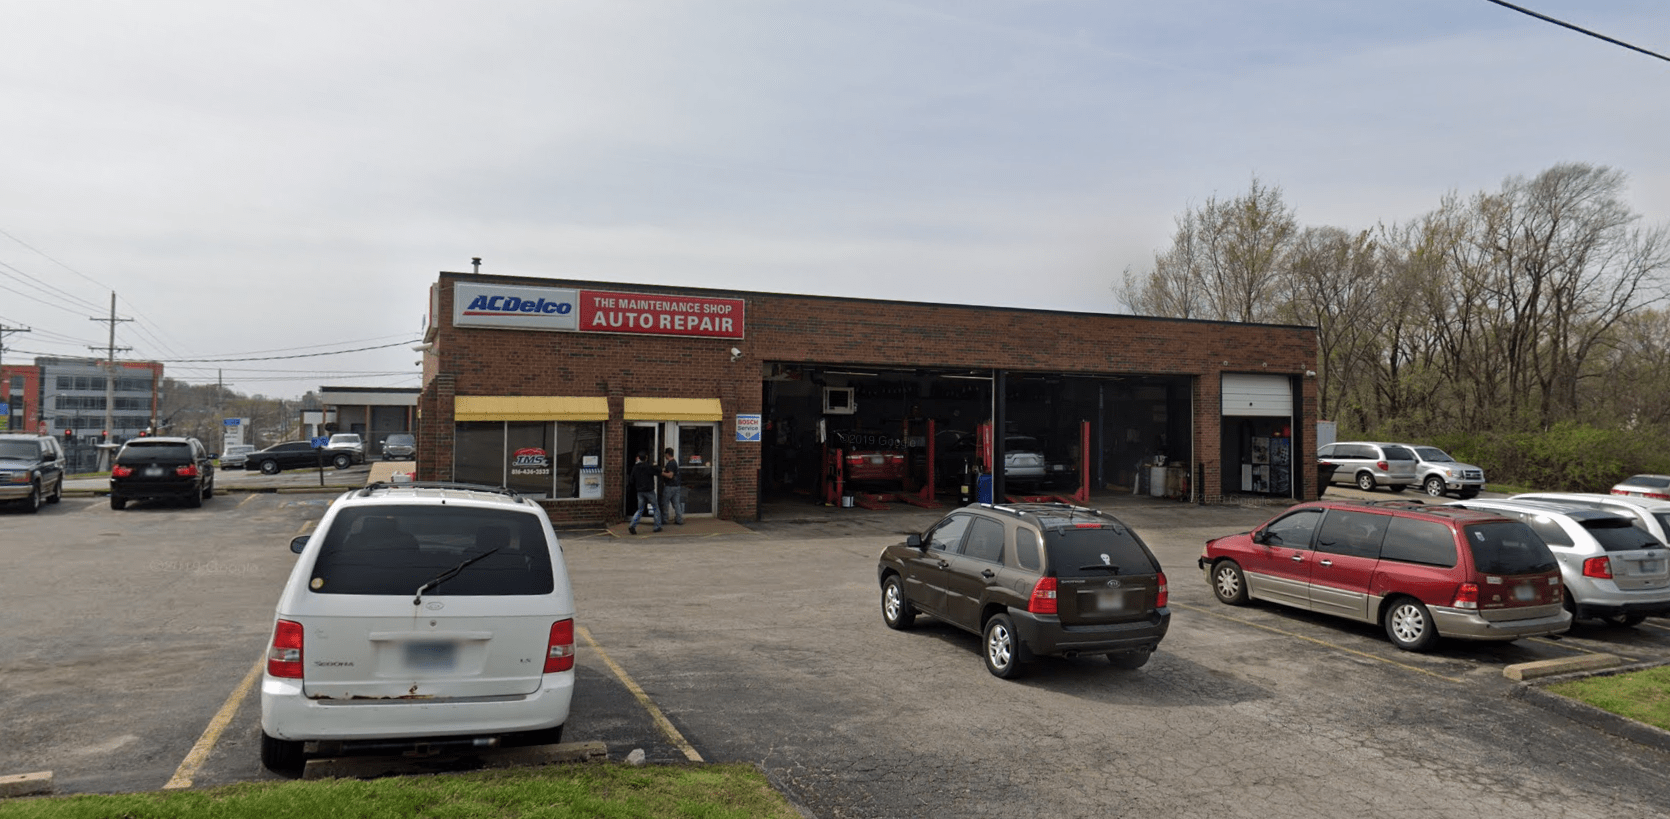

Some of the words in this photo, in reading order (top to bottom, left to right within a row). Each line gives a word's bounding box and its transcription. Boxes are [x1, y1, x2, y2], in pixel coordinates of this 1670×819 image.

[467, 295, 572, 314] ACDelco
[593, 297, 616, 308] THE
[618, 298, 701, 312] MAINTENANCE
[703, 303, 732, 314] SHOP
[592, 310, 654, 329] AUTO
[659, 314, 733, 332] REPAIR
